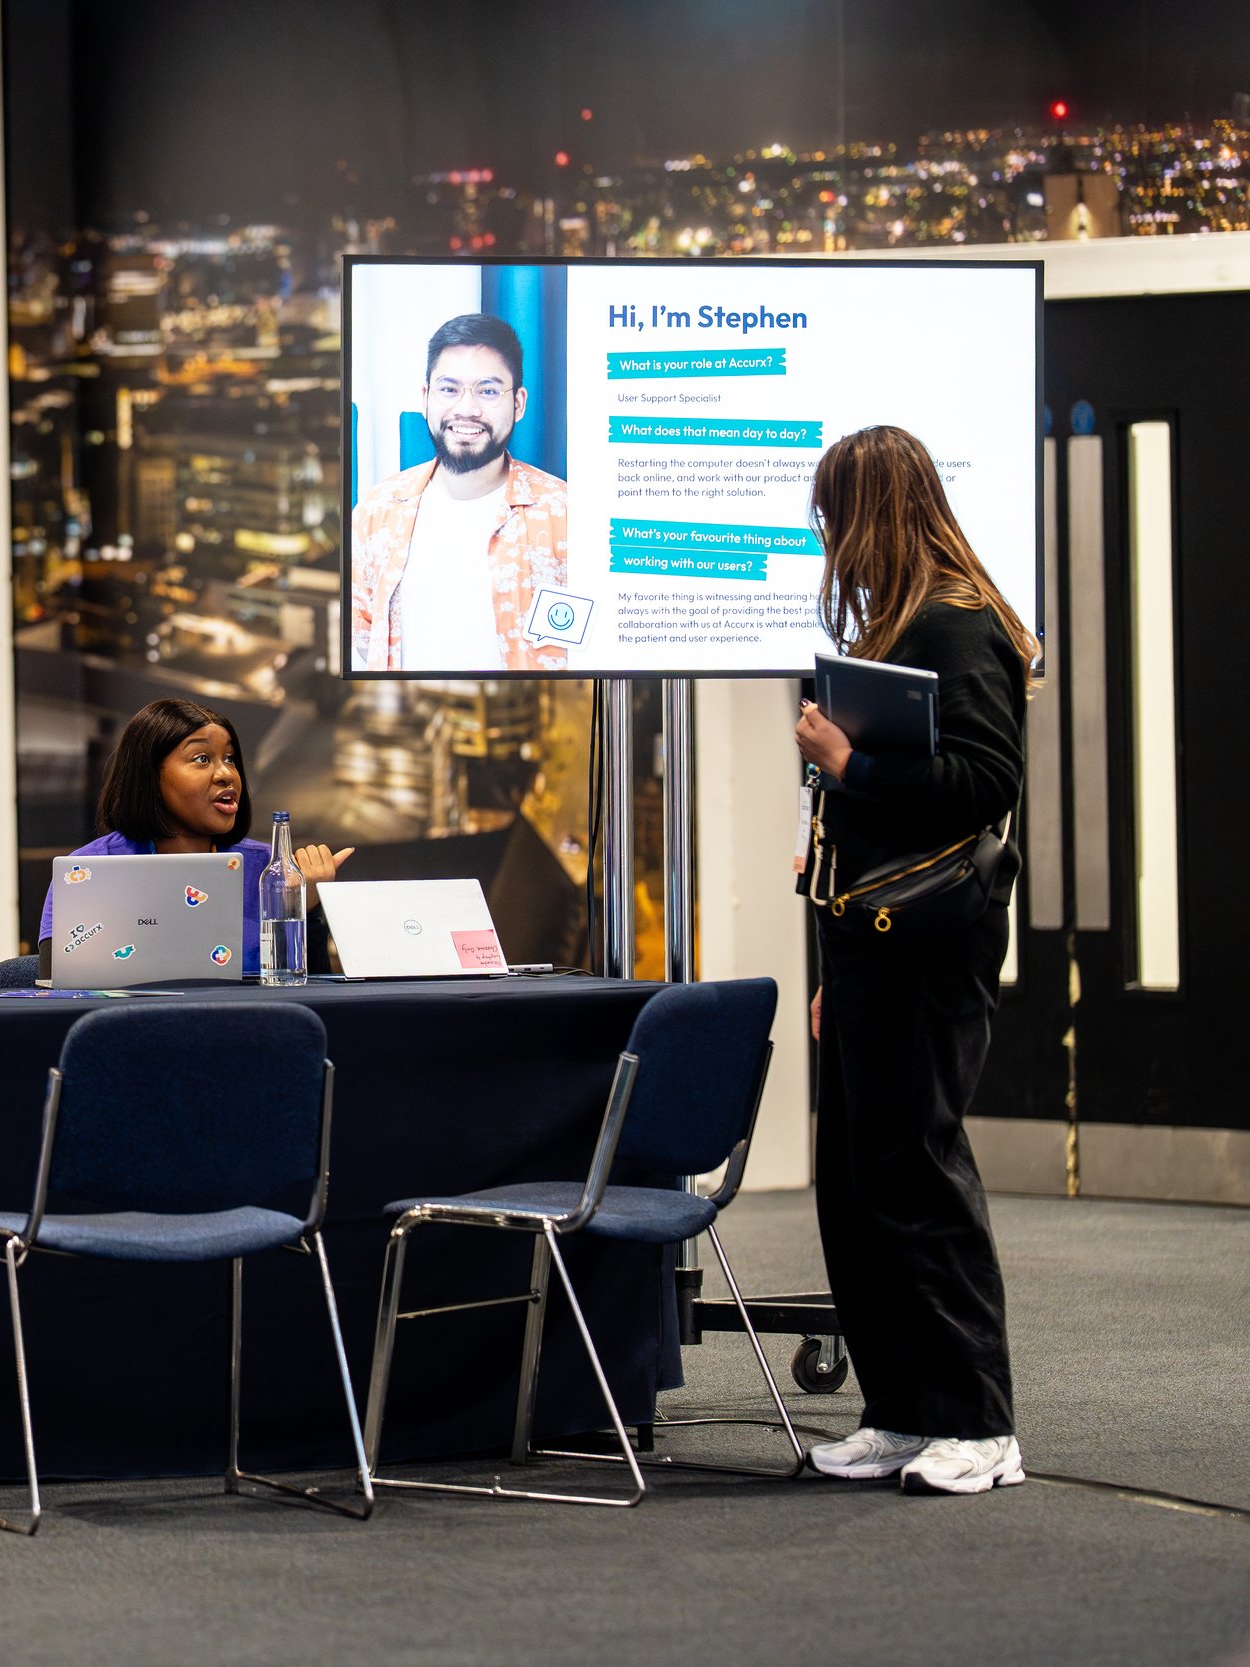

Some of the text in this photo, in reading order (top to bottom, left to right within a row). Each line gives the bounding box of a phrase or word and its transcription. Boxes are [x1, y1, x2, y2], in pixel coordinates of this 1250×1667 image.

[609, 304, 808, 335] Hi, I'm Stephen
[619, 355, 773, 373] What is your role at Accurx?
[617, 393, 721, 405] User Support Specialist
[621, 424, 807, 442] What does that mean day to day?
[618, 458, 668, 470] Restarting
[669, 458, 686, 468] the
[687, 458, 734, 470] computer
[735, 458, 770, 468] doesn't
[772, 458, 806, 470] always
[946, 460, 972, 468] users
[617, 472, 641, 482] back
[642, 473, 675, 483] online,
[676, 473, 696, 483] and
[697, 473, 721, 482] work
[722, 473, 744, 482] with
[745, 475, 762, 483] our
[763, 473, 801, 484] product
[617, 487, 766, 499] point them to the right solution.
[622, 527, 807, 548] What's your favourite thing about
[623, 555, 754, 573] working with our users?
[618, 592, 632, 603] My
[633, 592, 670, 601] favorite
[671, 592, 695, 604] thing
[696, 592, 704, 601] is
[705, 592, 752, 603] witnessing
[753, 592, 772, 601] and
[772, 592, 808, 603] hearing
[617, 606, 650, 617] always
[650, 606, 671, 615] with
[672, 606, 687, 615] the
[688, 606, 709, 617] goal
[710, 605, 720, 615] of
[722, 606, 765, 617] providing
[766, 606, 782, 615] the
[782, 605, 802, 615] best
[617, 620, 678, 629] collaboration
[679, 619, 699, 629] with
[711, 620, 722, 629] at
[723, 619, 755, 629] Accurx
[756, 620, 764, 629] is
[764, 619, 788, 629] what
[618, 633, 762, 644] the patient and user experience.
[75, 924, 103, 946] accurx
